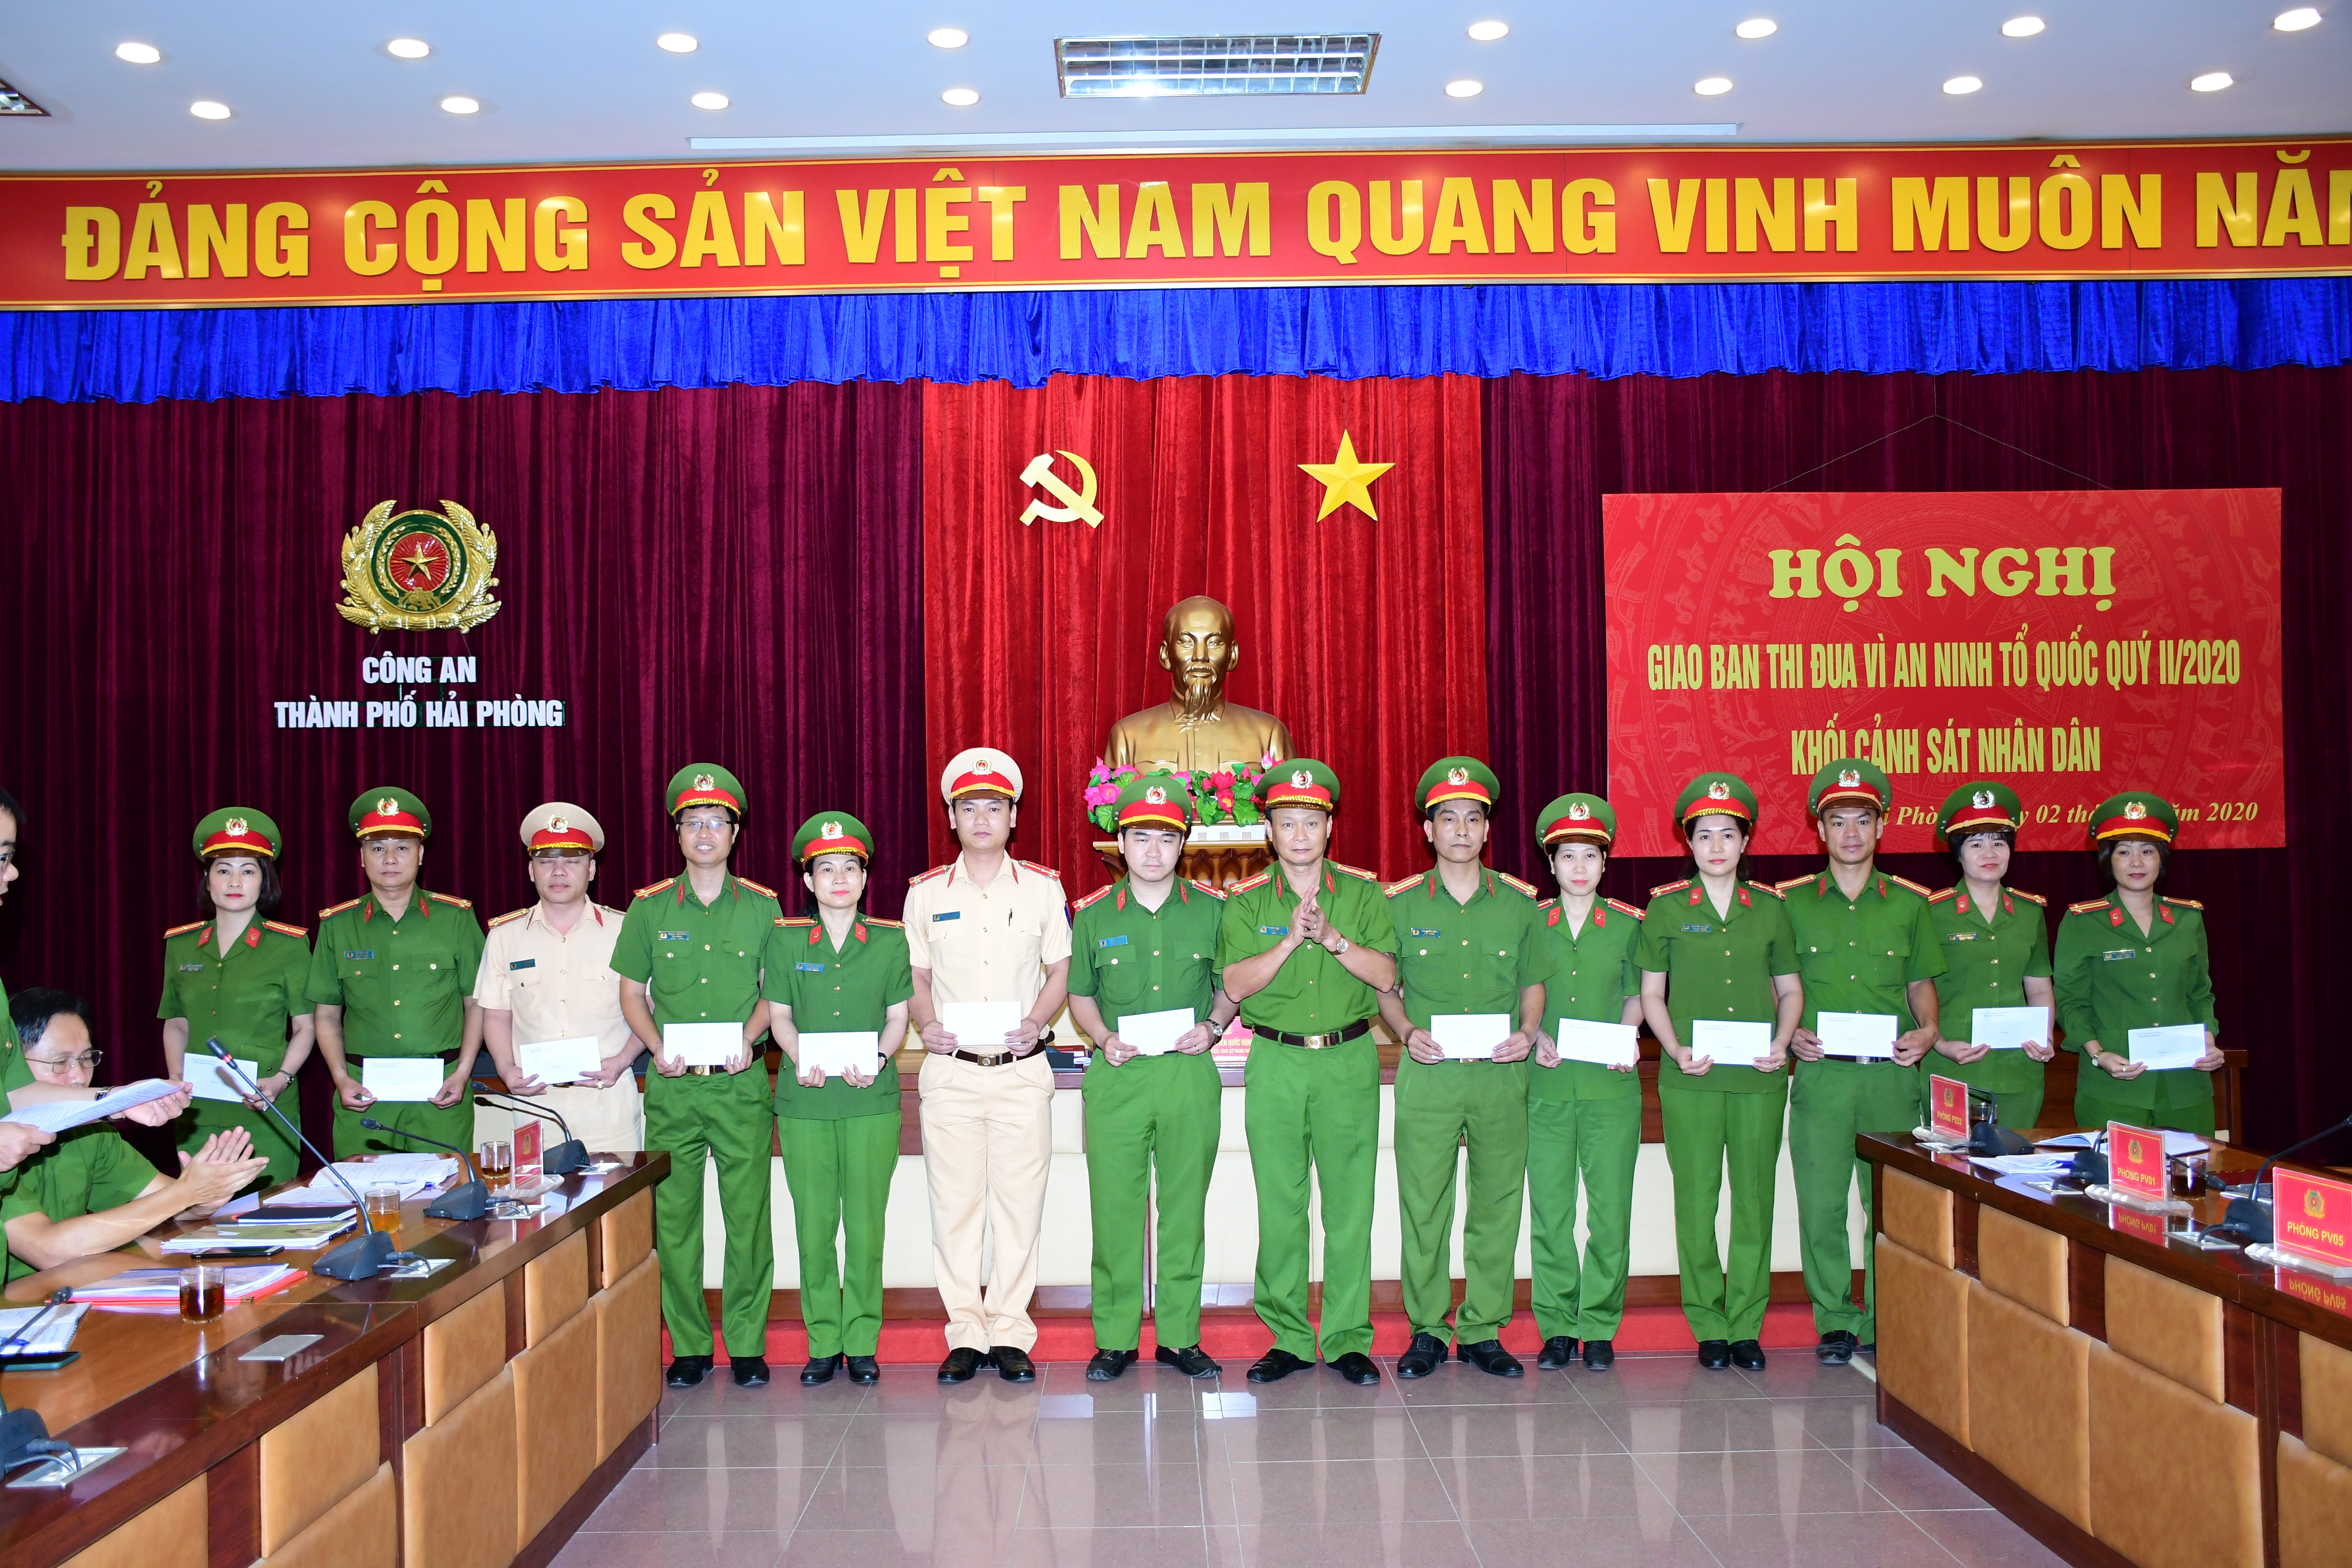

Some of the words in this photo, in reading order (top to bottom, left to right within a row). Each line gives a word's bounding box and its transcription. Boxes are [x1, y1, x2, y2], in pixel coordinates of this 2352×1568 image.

[62, 181, 309, 280] ĐẢNG
[343, 180, 588, 291] CỘNG
[621, 169, 805, 269] SẢN
[836, 168, 1026, 278] VIỆT
[1058, 182, 1271, 259] NAM
[1307, 177, 1616, 265] QUANG
[1647, 177, 1858, 252] VINH
[1892, 155, 2161, 252] MUÔN
[1768, 533, 1903, 612] HỘI
[1925, 547, 2116, 611] NGHỊ
[362, 651, 431, 683] CÔNG
[439, 656, 476, 683] AN
[1647, 644, 1702, 690] GIAO
[1710, 644, 1759, 689] BAN
[1767, 644, 1803, 689] THI
[1810, 643, 1857, 689] ĐUA
[1864, 633, 1886, 688] VÌ
[1894, 642, 1927, 687] AN
[1935, 642, 1992, 687] NINH
[1999, 623, 2028, 687] TỔ
[2036, 624, 2098, 691] QUỐC
[2107, 630, 2151, 691] QUÝ
[2159, 639, 2240, 685] II/2020
[274, 695, 358, 728] THÀNH
[367, 690, 417, 727] PHỐ
[426, 690, 468, 727] HẢI
[476, 694, 563, 727] PHÒNG
[1791, 713, 1847, 775] KHỐI
[1854, 713, 1919, 774] CẢNH
[1927, 718, 1971, 773] SÁT
[1978, 718, 2044, 773] NHÂN
[2052, 717, 2100, 772] DÂN
[1895, 806, 1938, 825] Phò
[2036, 804, 2061, 824] 02
[2172, 803, 2200, 821] ăm
[2206, 802, 2258, 821] 2020
[1228, 1037, 1241, 1047] QUỐC
[1937, 1111, 1951, 1122] PHÒNG
[2117, 1167, 2139, 1181] PHÒNG
[2140, 1173, 2156, 1186] PV01
[2287, 1221, 2319, 1240] PHÒNG
[2321, 1230, 2344, 1247] PV05
